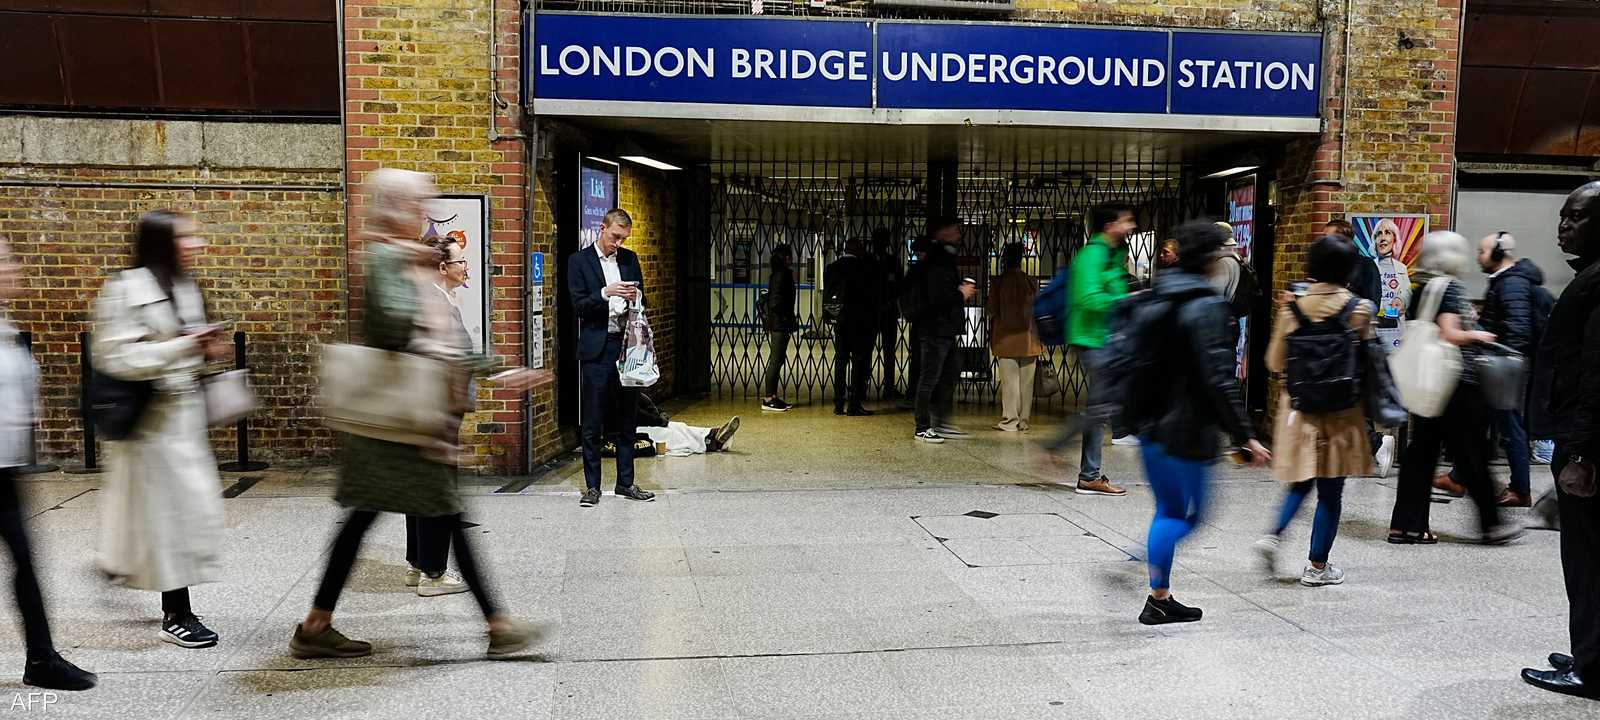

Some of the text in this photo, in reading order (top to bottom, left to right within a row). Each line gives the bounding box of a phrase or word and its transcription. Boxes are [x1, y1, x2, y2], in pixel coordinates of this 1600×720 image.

[540, 44, 1315, 91] LONDON BRIDGE UNDERGROUND STATION
